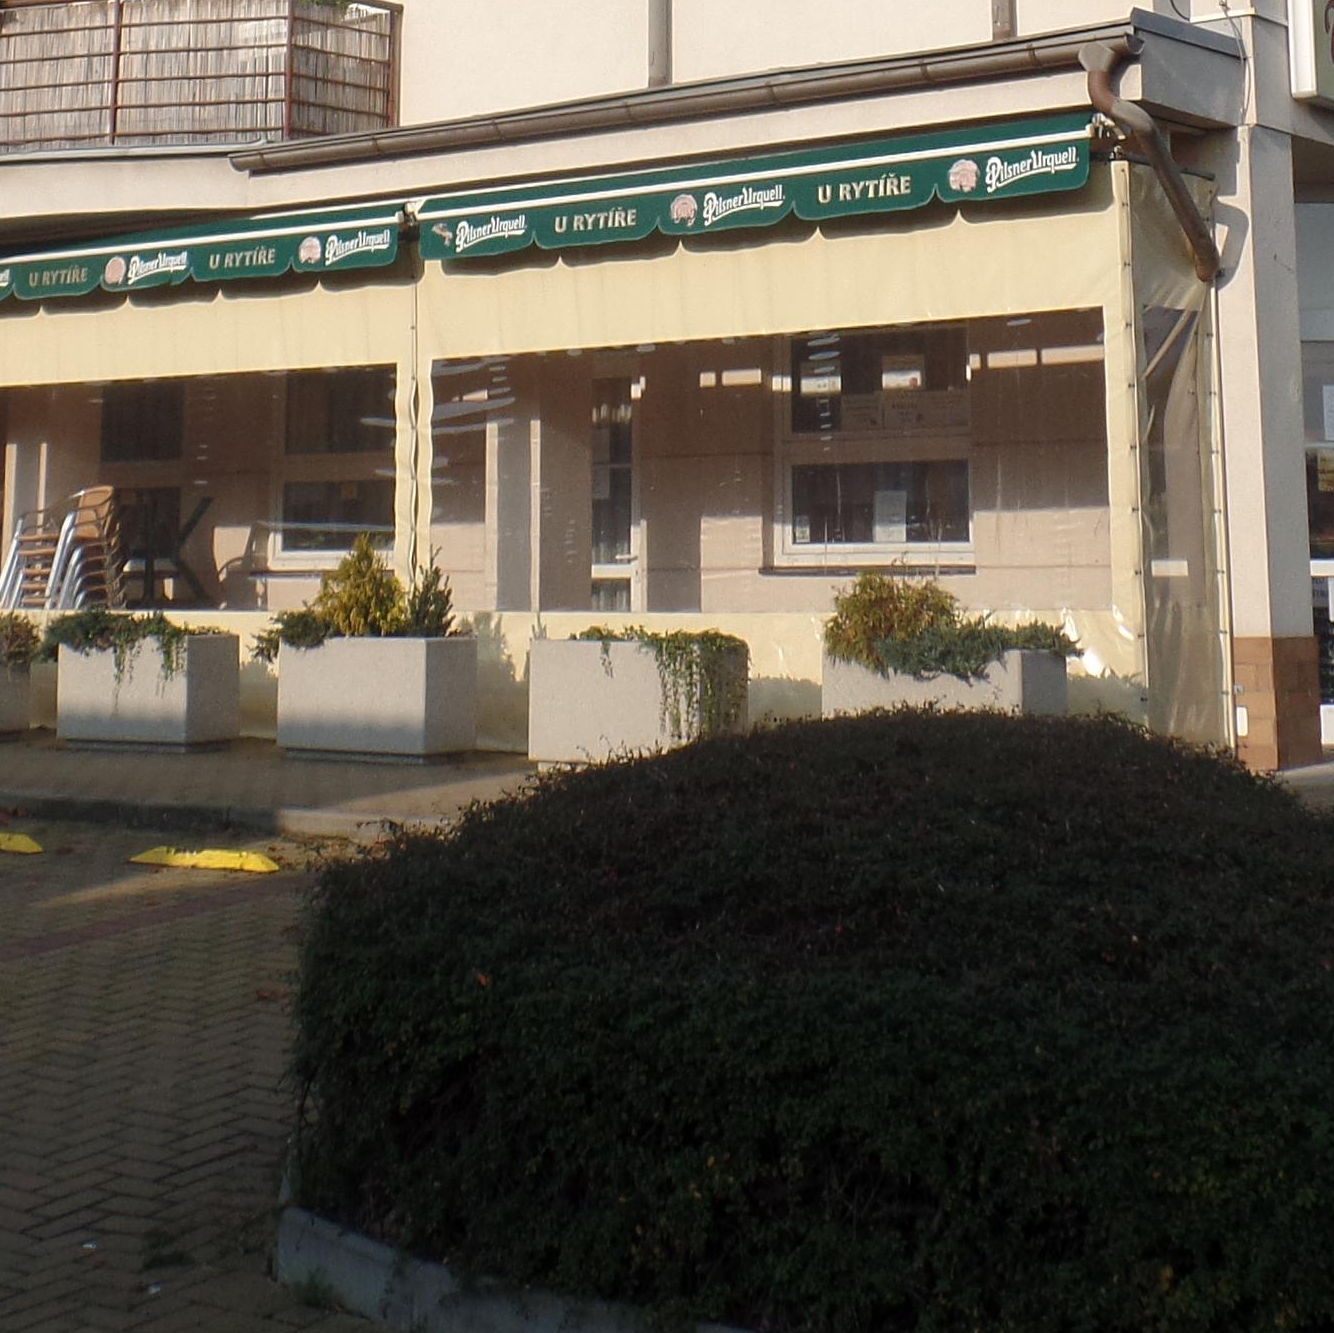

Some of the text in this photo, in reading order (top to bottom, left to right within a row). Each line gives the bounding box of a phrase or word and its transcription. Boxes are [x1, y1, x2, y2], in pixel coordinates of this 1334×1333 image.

[985, 147, 1078, 193] Pilsner Urquell
[818, 172, 911, 203] U RYTÍŘE
[554, 207, 637, 234] U RYTÍŘE
[703, 185, 785, 226] Pilsner Urquell
[325, 229, 390, 266] Pilsner Urquell
[456, 215, 526, 252] Pilsner Urquell
[209, 254, 220, 269] U
[28, 272, 40, 287] U
